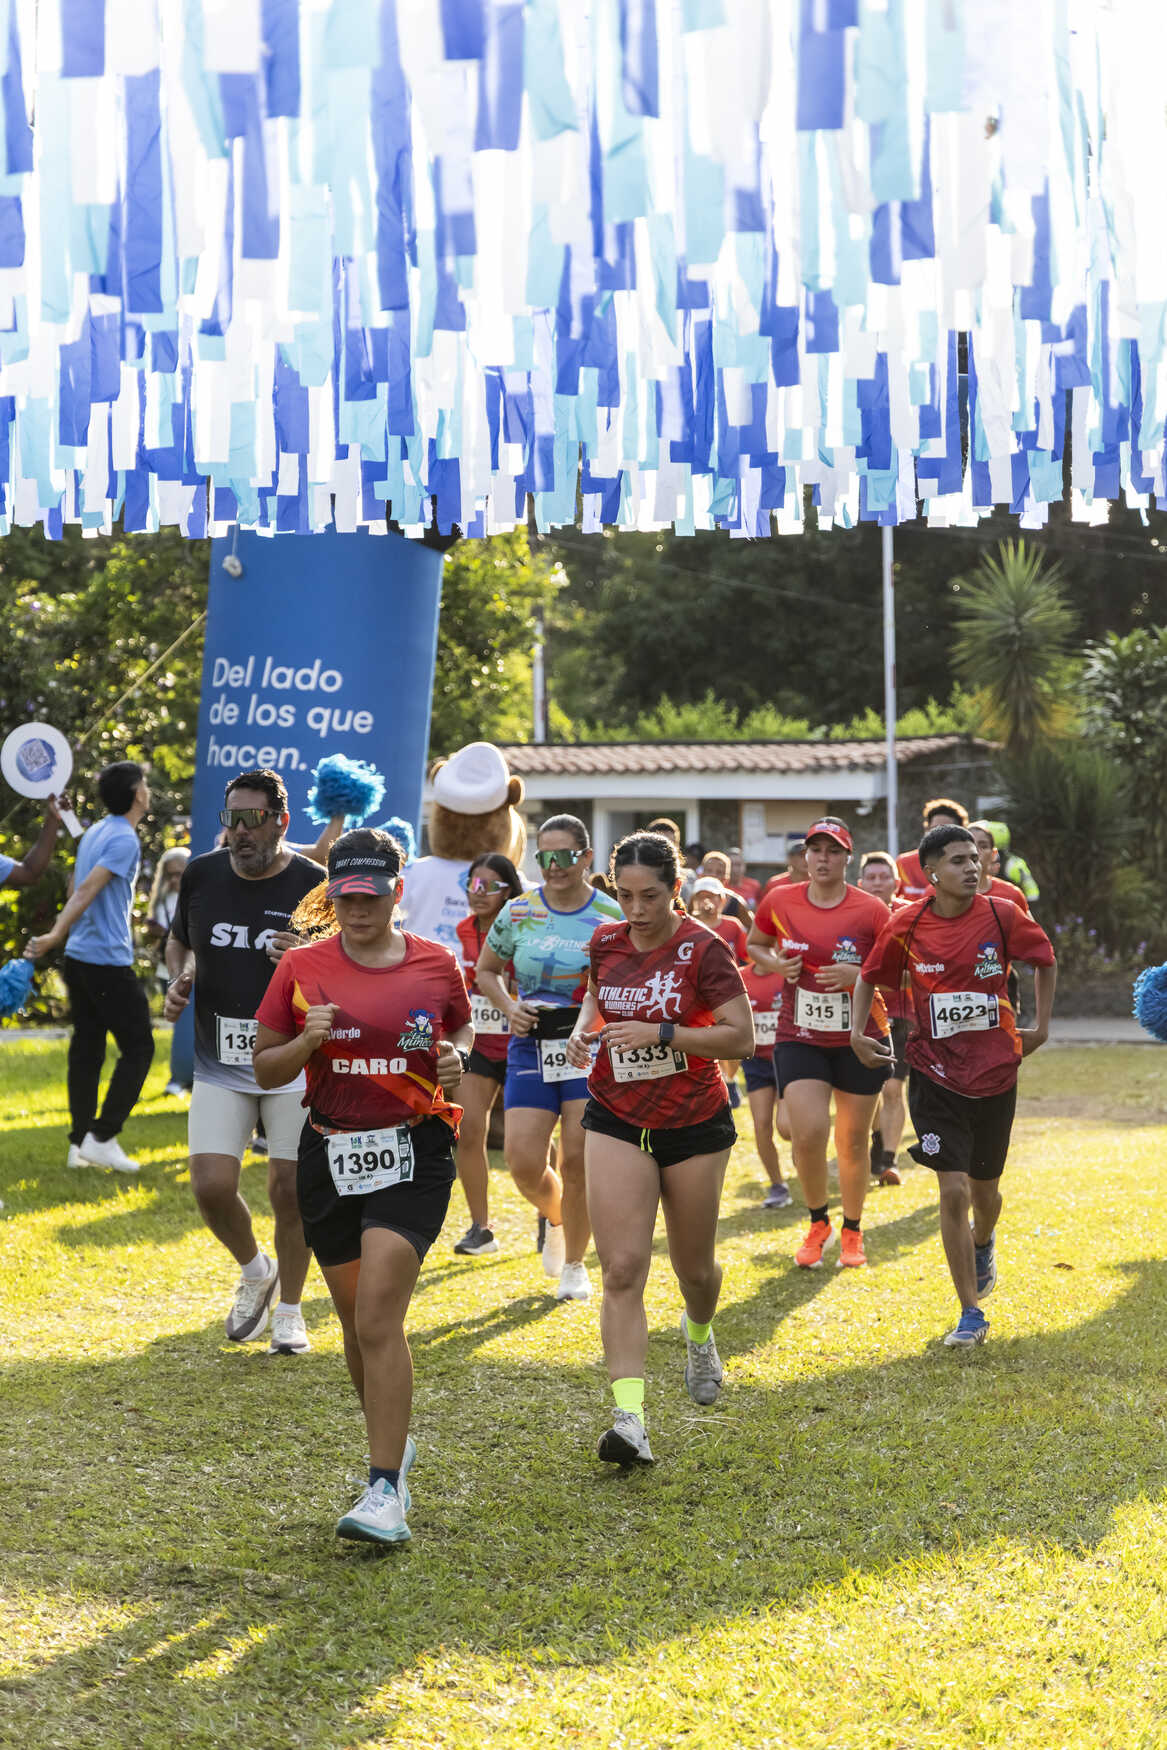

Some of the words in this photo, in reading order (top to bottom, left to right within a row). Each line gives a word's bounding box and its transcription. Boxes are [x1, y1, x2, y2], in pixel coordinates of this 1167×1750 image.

[212, 655, 255, 688] Del
[261, 656, 343, 693] lado
[209, 693, 240, 725] de
[247, 693, 296, 727] los
[306, 706, 374, 738] que
[207, 735, 307, 771] hacen.
[677, 942, 695, 960] G
[598, 986, 649, 1002] ATHLETIC
[473, 1008, 501, 1022] 160
[805, 1003, 834, 1019] 315
[936, 1005, 988, 1023] 4623
[225, 1033, 257, 1050] 136
[543, 1052, 567, 1068] 49
[618, 1041, 668, 1064] 1333
[332, 1057, 408, 1075] CARO
[333, 1149, 395, 1175] 1390
